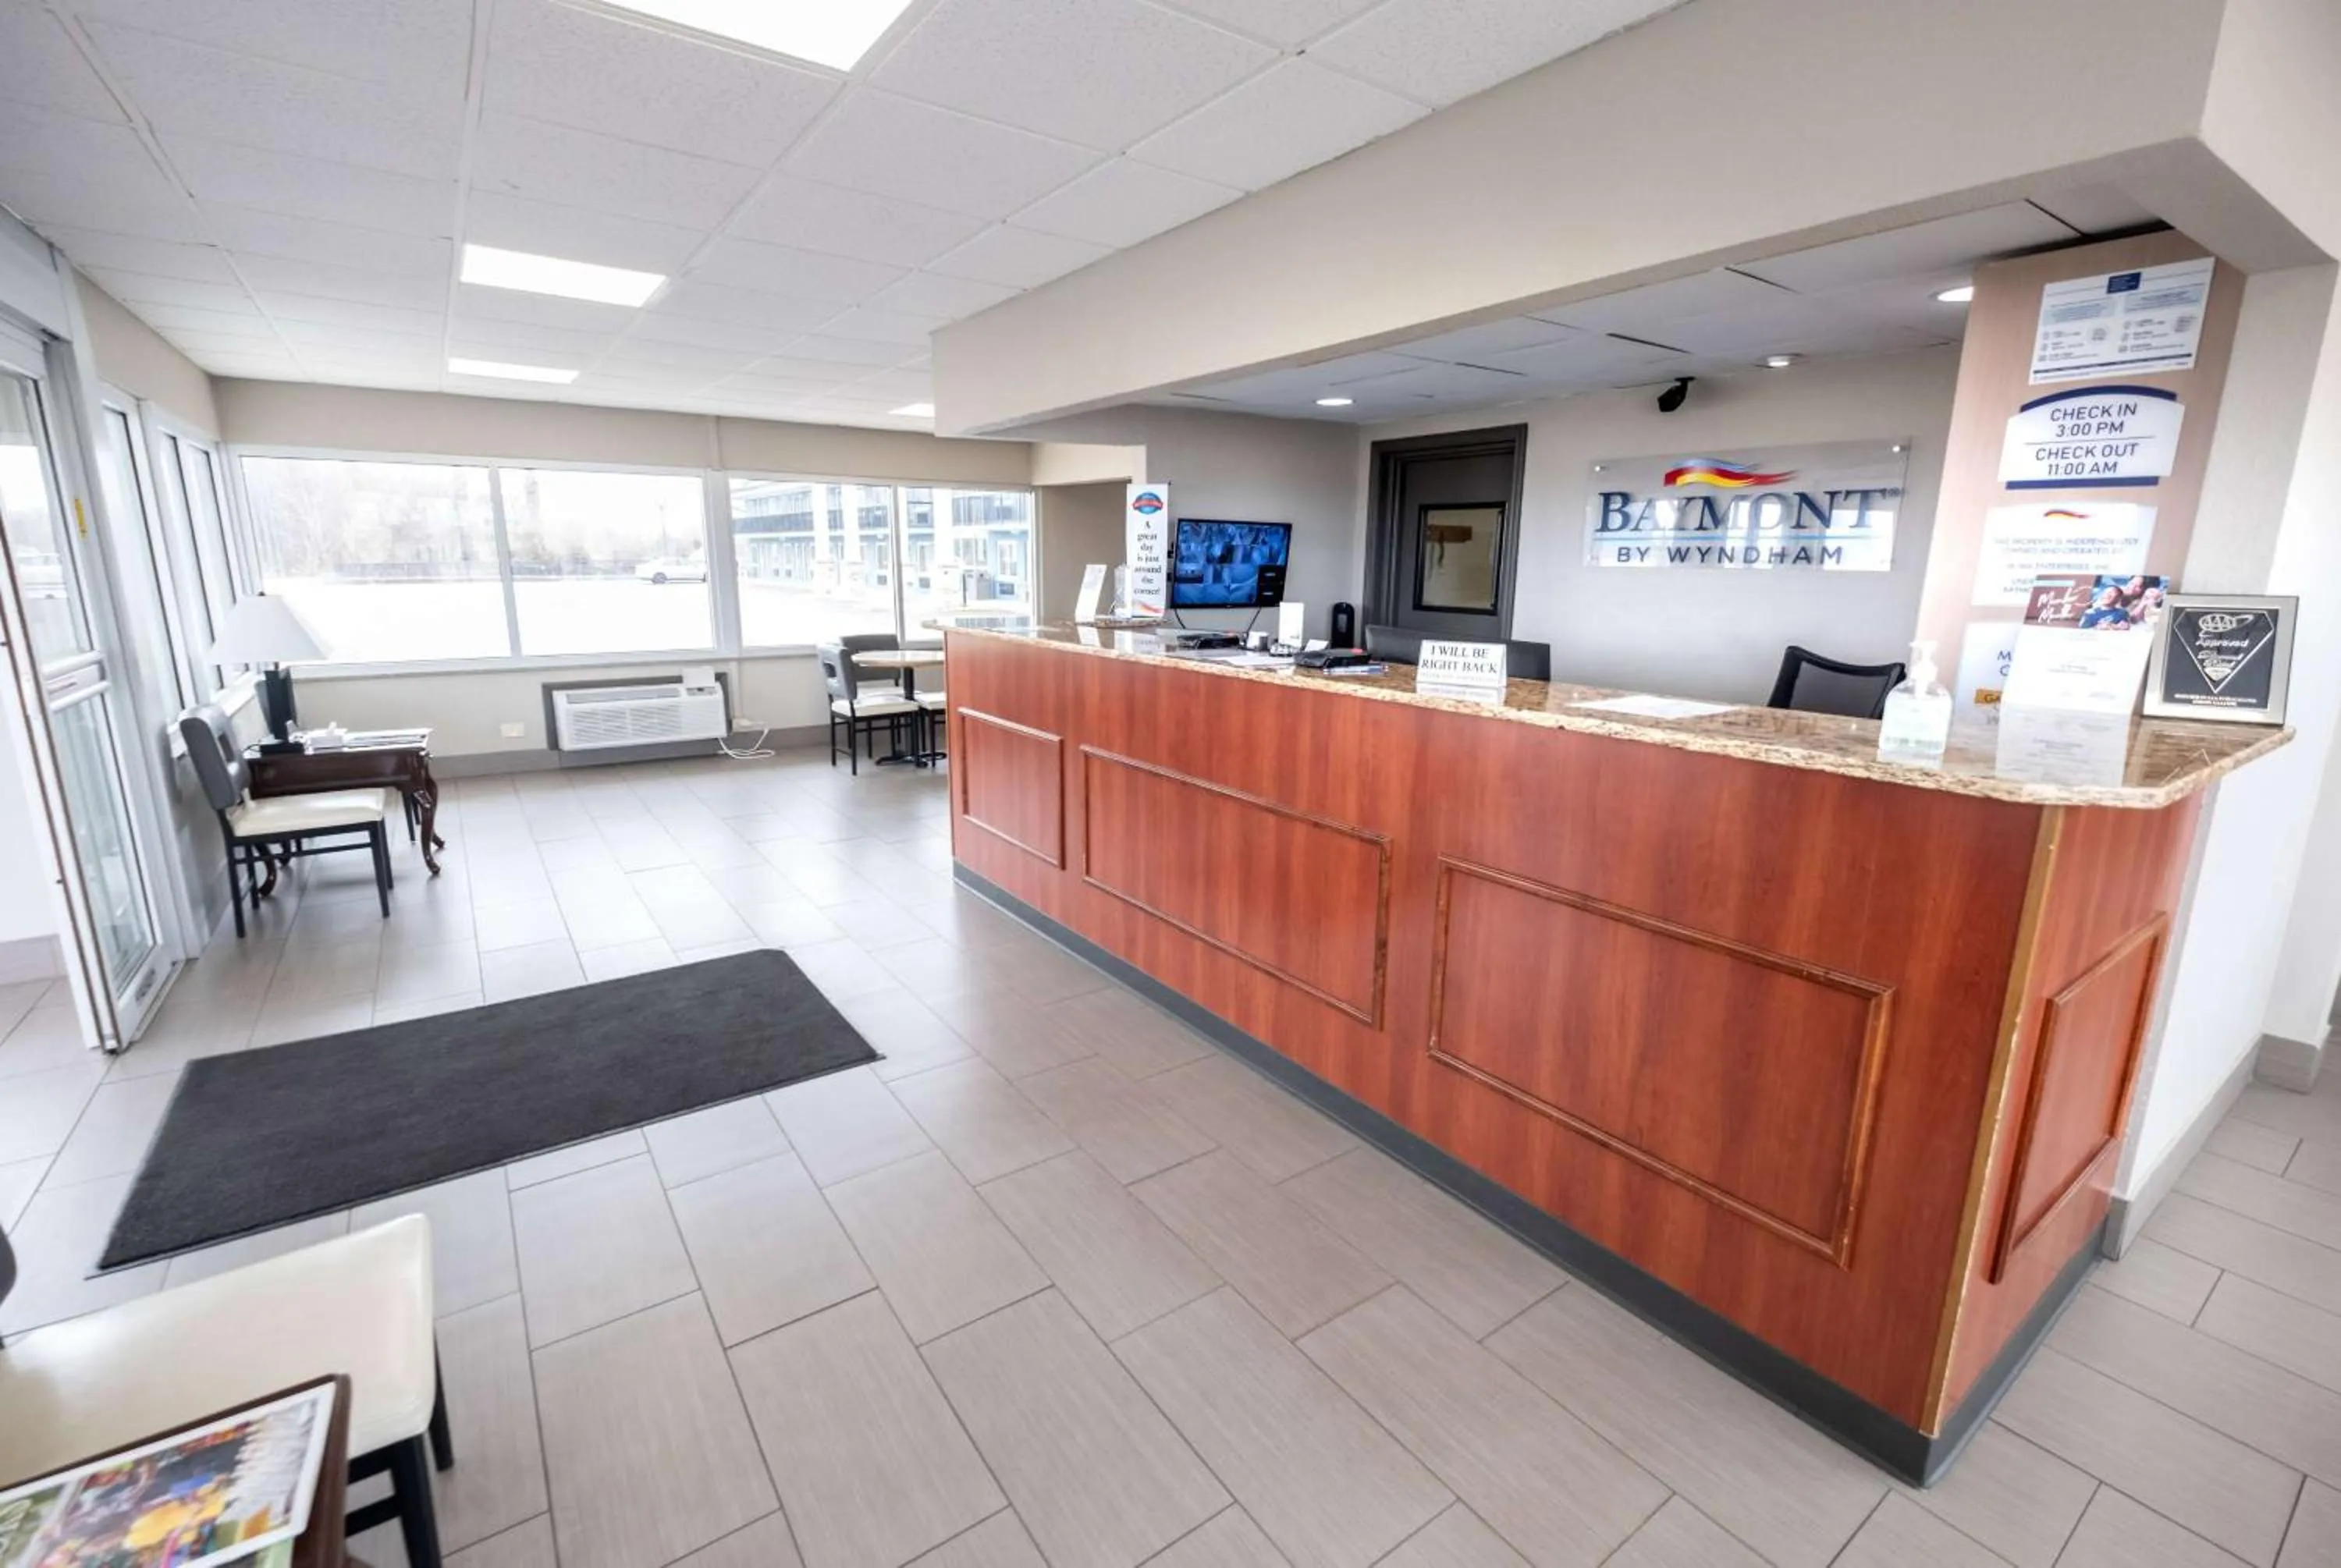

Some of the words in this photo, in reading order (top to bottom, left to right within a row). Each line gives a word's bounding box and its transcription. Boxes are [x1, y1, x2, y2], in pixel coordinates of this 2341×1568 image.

[2050, 404, 2113, 422] CHECK
[2117, 403, 2137, 417] IN
[2055, 422, 2091, 438] 3:00
[2095, 420, 2125, 435] PM
[2035, 445, 2098, 461] CHECK
[2101, 442, 2140, 458] OUT
[2047, 462, 2086, 476] 11:00
[2088, 461, 2119, 474] AM
[1594, 488, 1888, 534] BAYMONT
[1137, 533, 1157, 542] great
[1140, 543, 1153, 554] day
[1617, 546, 1654, 563] BY
[1668, 545, 1845, 566] WYNDHAM
[1137, 553, 1143, 562] is
[1145, 553, 1160, 565] just
[1134, 565, 1162, 573] around
[1141, 576, 1154, 584] the
[1430, 644, 1436, 656] I
[1438, 645, 1471, 658] WILL
[1472, 647, 1490, 658] BE
[1421, 658, 1461, 671] RIGHT
[1462, 661, 1498, 674] BACK
